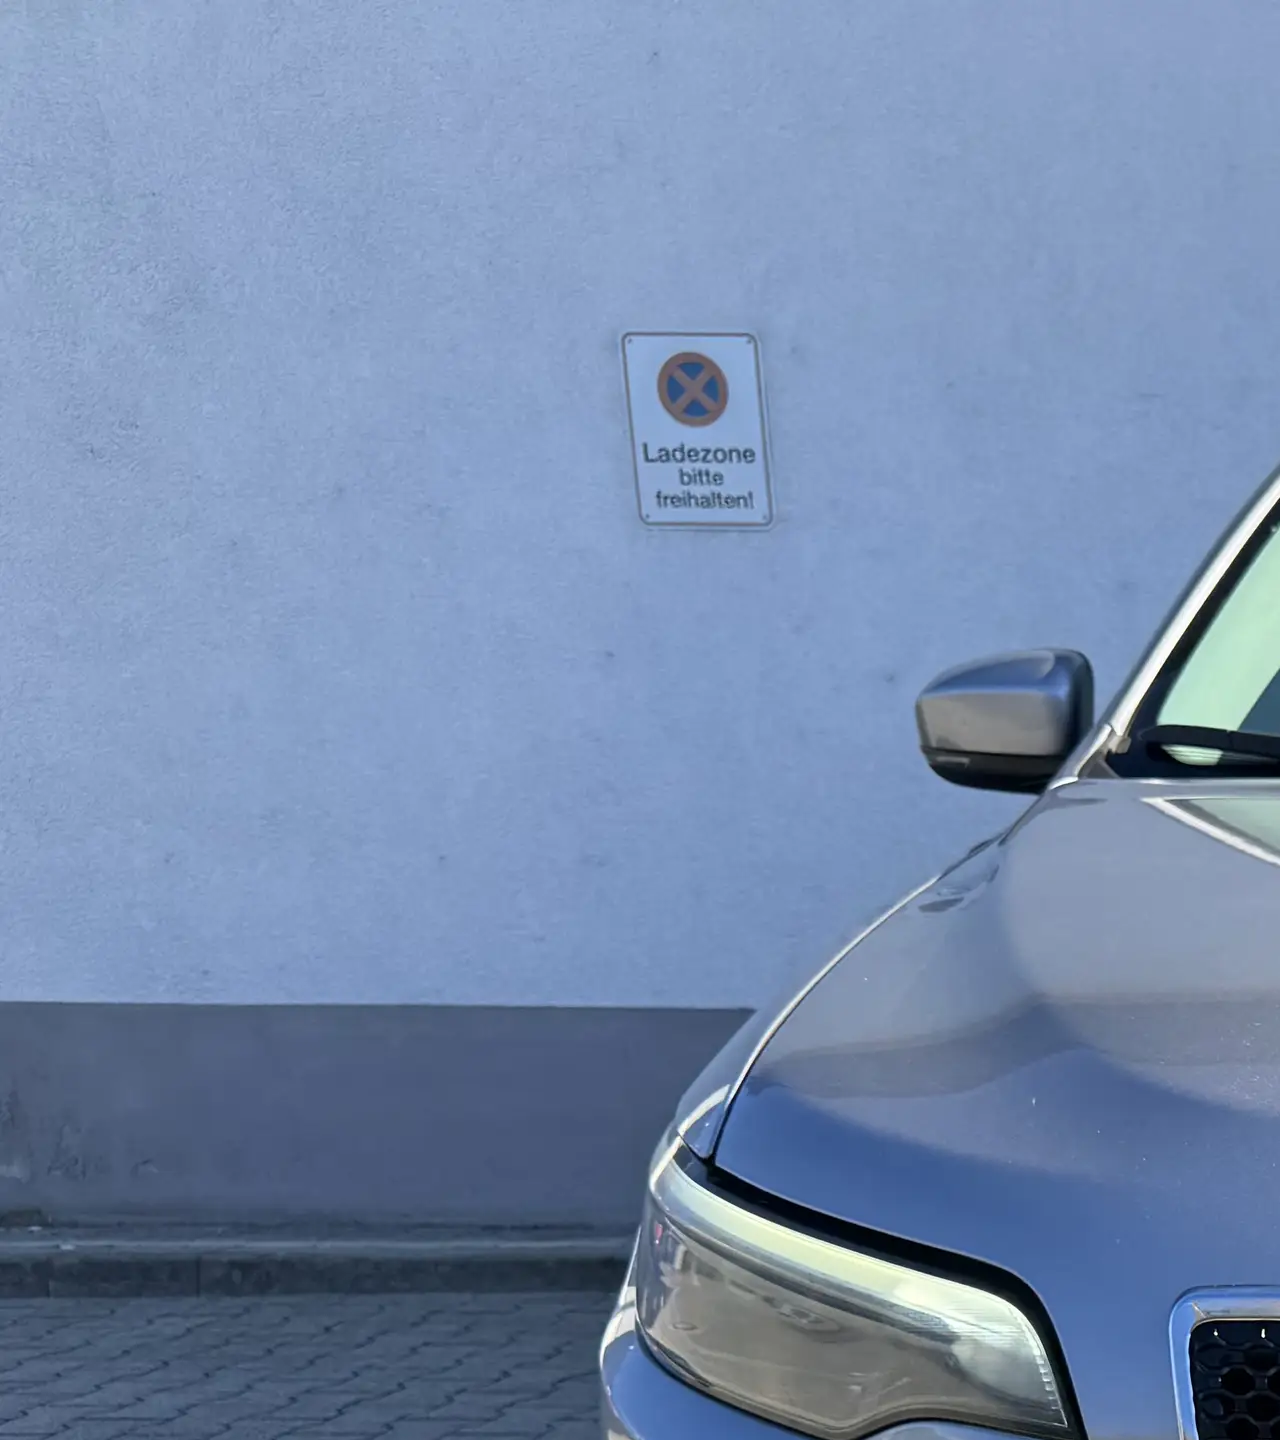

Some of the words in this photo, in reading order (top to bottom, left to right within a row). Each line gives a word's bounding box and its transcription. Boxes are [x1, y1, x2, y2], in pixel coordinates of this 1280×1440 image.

[642, 442, 756, 463] Ladezone
[679, 469, 724, 486] bitte
[656, 491, 754, 509] freihalten!
